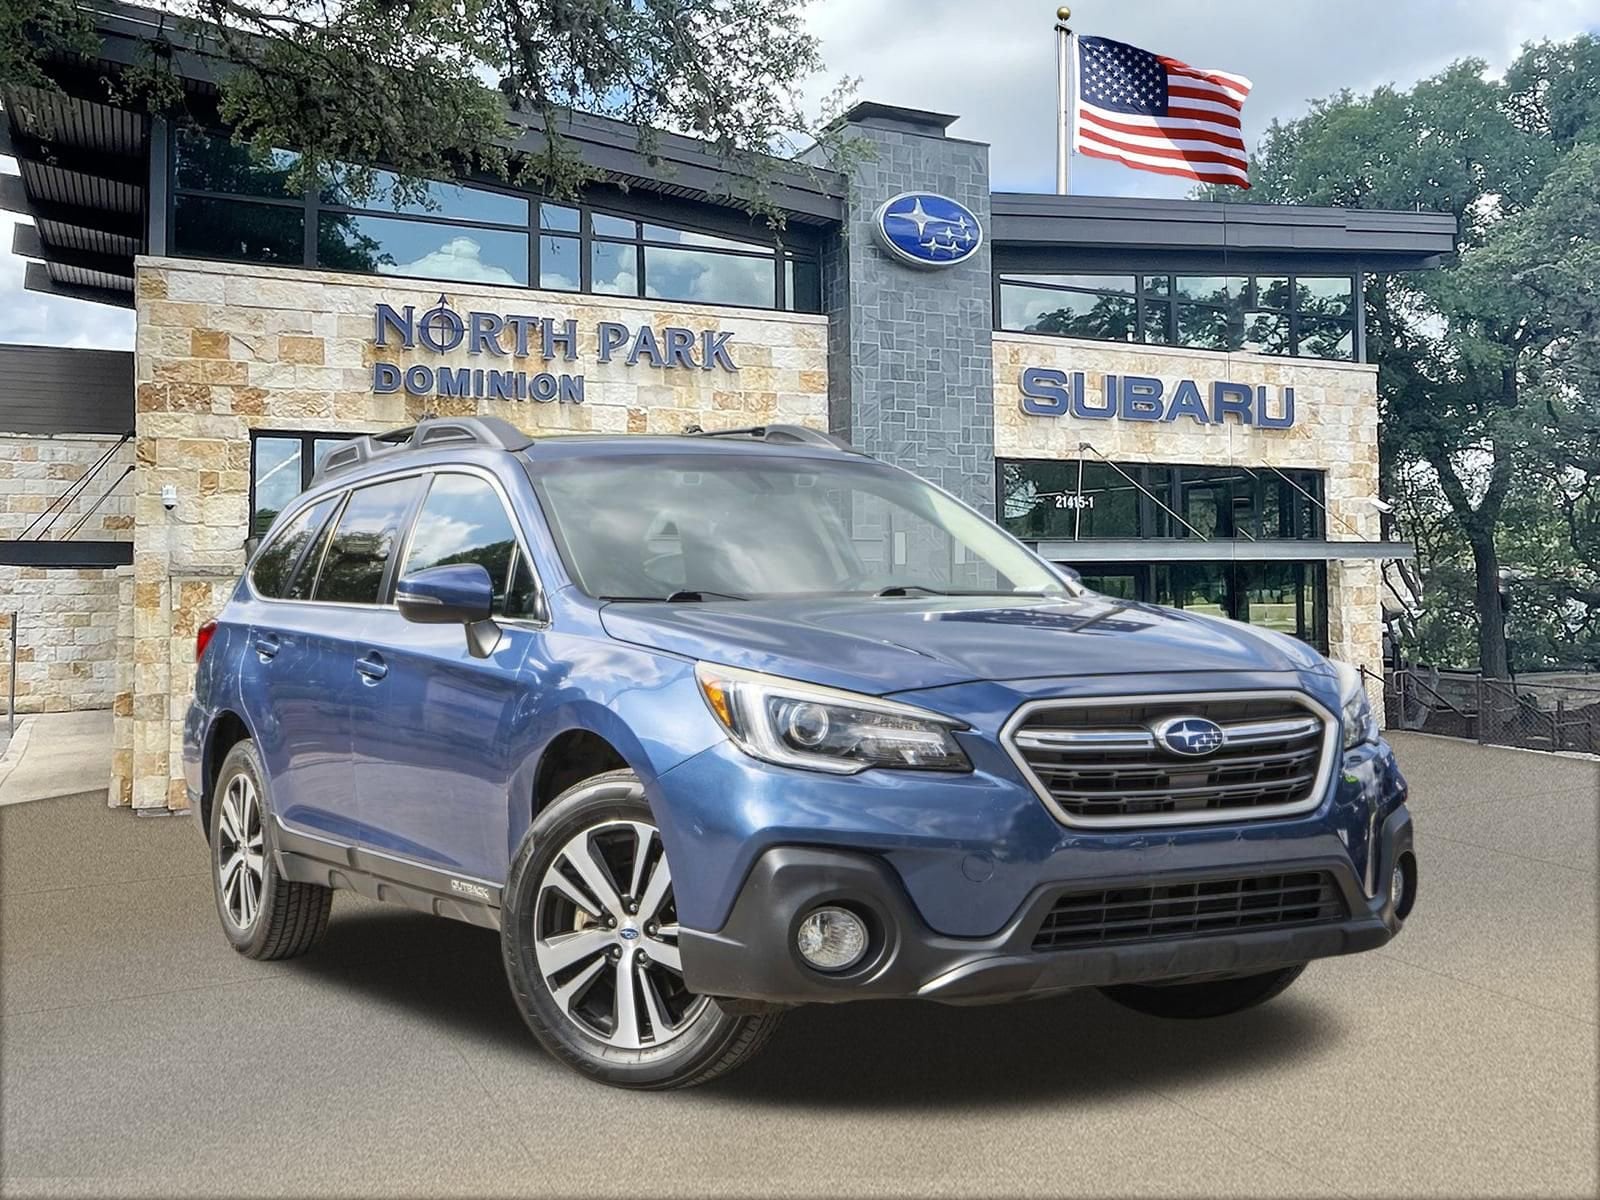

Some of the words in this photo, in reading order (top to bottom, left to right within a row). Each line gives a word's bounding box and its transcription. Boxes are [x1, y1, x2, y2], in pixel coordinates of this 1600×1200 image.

[374, 294, 579, 361] NORTH
[597, 321, 742, 373] PARK
[373, 362, 585, 405] DOMINION
[1018, 366, 1295, 430] SUBARU
[1055, 495, 1094, 509] 21415-1
